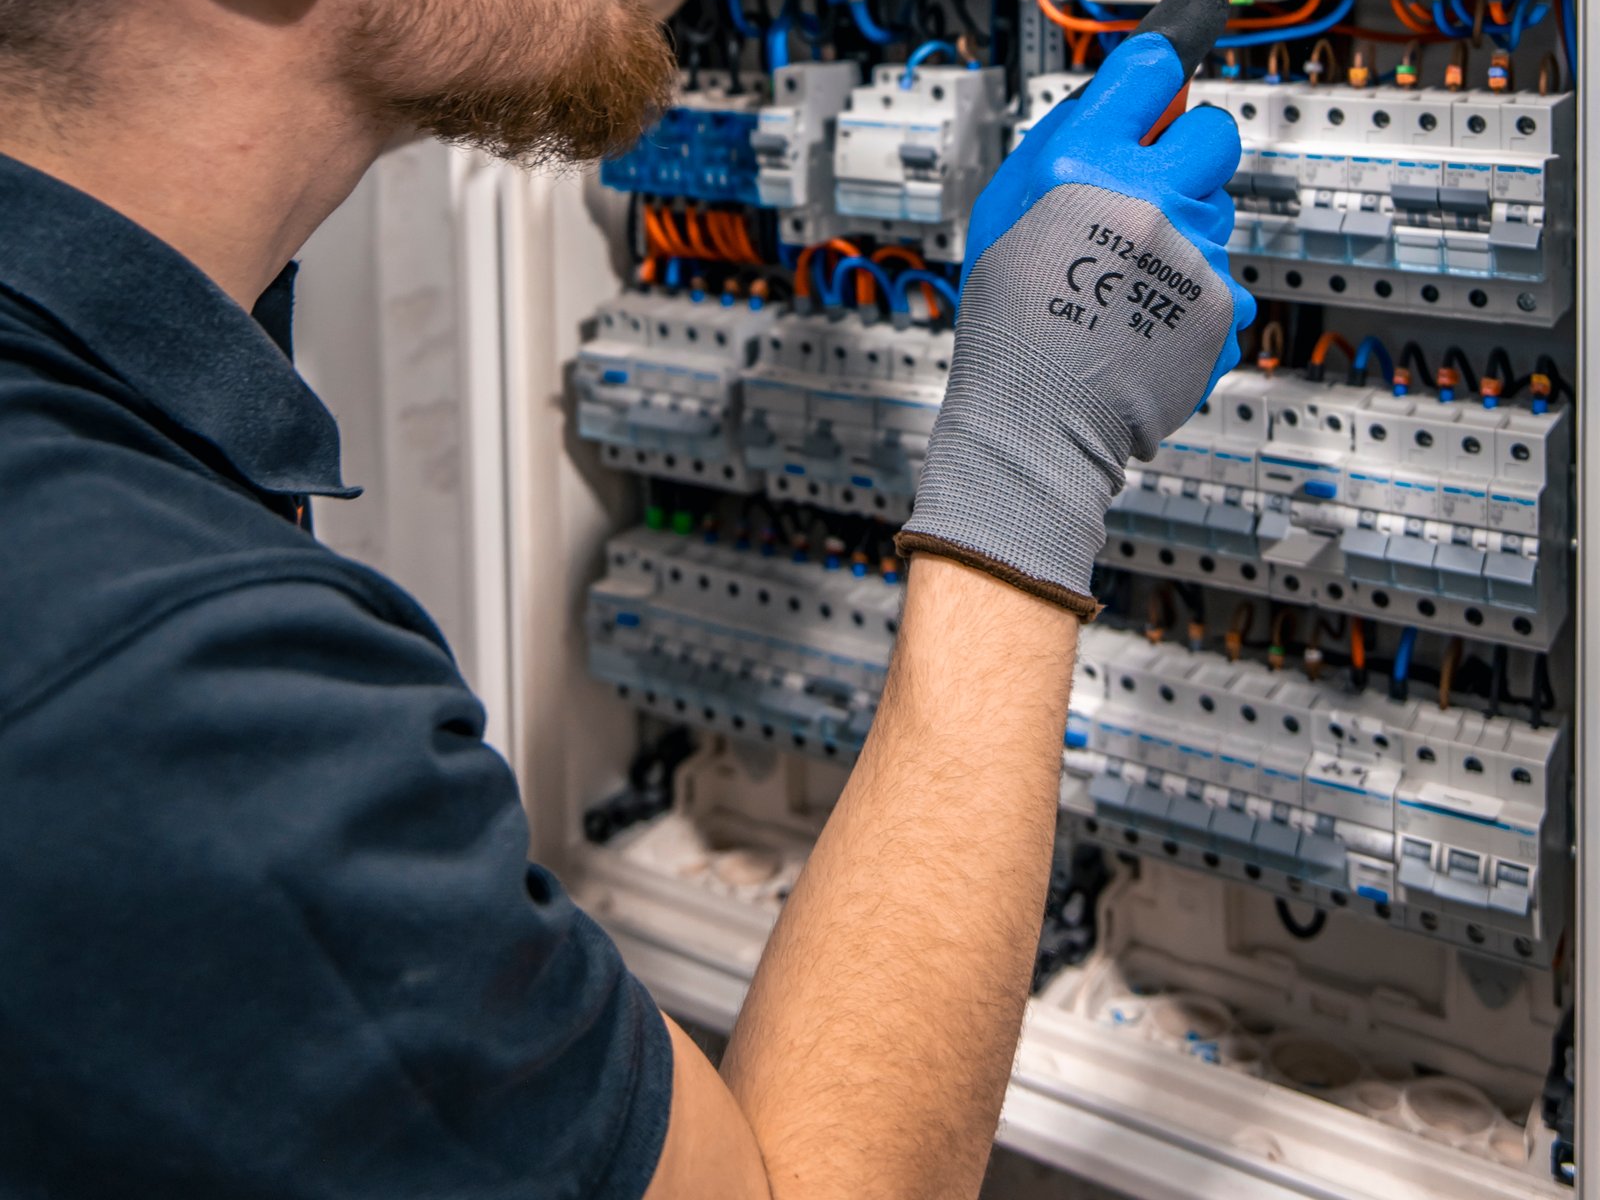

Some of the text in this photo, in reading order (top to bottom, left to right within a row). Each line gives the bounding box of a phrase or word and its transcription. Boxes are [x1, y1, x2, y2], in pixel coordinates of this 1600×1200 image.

[1066, 256, 1124, 307] CE
[1088, 223, 1202, 301] 1512-600009
[1049, 297, 1086, 325] CAT.
[1127, 281, 1186, 330] SIZE
[1128, 312, 1154, 339] 9/L
